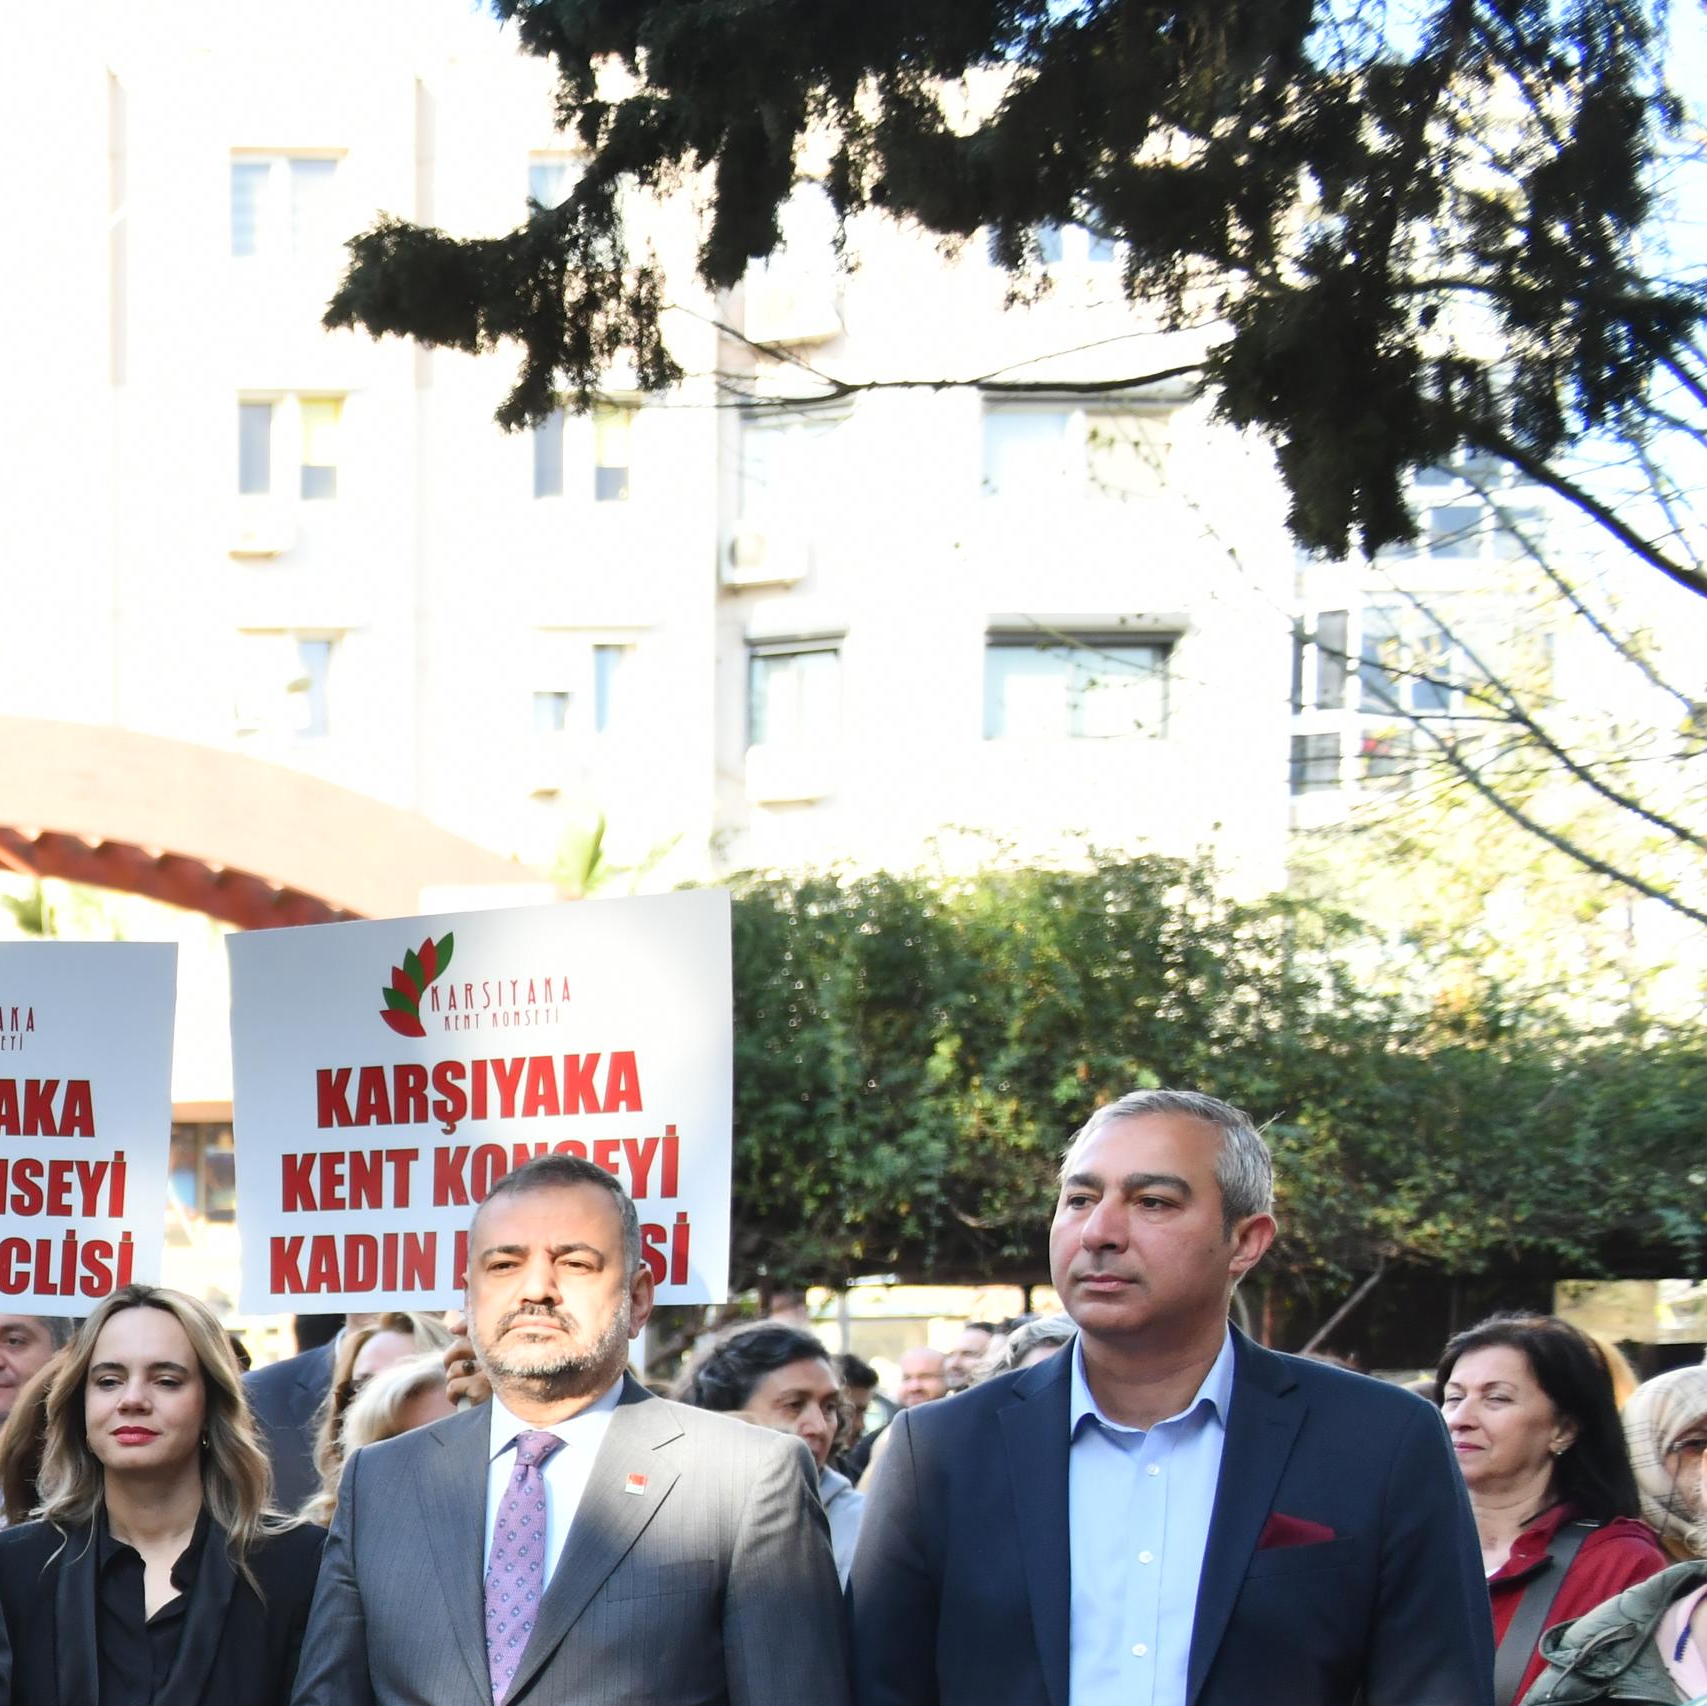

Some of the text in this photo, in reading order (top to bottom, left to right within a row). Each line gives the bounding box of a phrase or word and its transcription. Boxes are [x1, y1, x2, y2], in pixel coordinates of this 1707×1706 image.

[430, 976, 572, 1012] KARŞIYAKA
[444, 1006, 559, 1031] KENT KONSEYİ
[316, 1050, 643, 1135] KARŞIYAKA
[281, 1148, 419, 1213] KENT
[269, 1231, 437, 1294] KADIN
